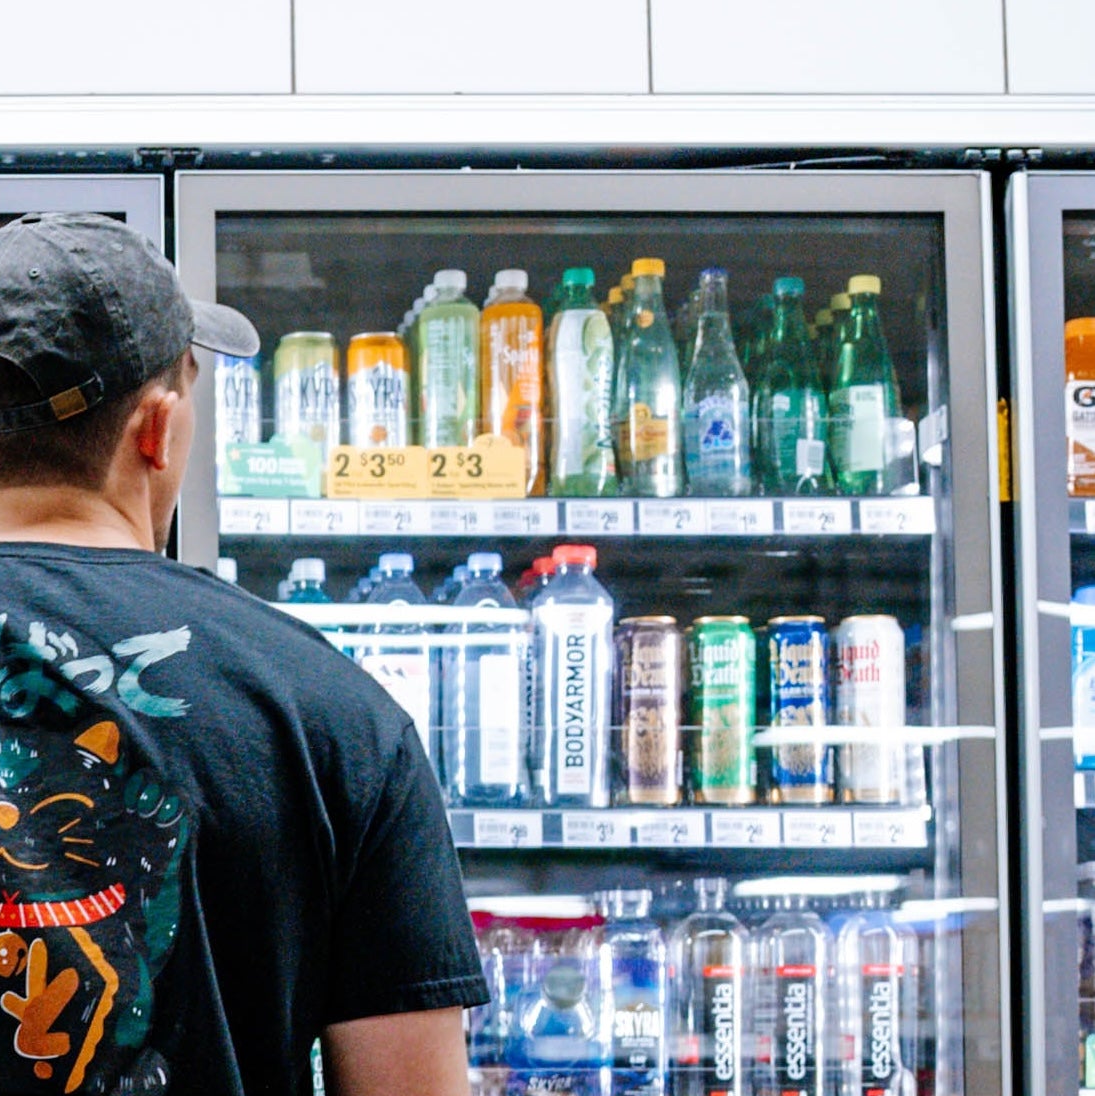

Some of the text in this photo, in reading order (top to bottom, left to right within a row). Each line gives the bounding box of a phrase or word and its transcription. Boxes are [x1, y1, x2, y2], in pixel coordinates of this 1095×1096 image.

[335, 455, 350, 477] 2
[431, 453, 482, 477] 2 $3
[565, 633, 586, 769] BODYARMOR
[711, 983, 734, 1080] essentia
[784, 983, 807, 1080] essentia
[869, 981, 891, 1079] essentia
